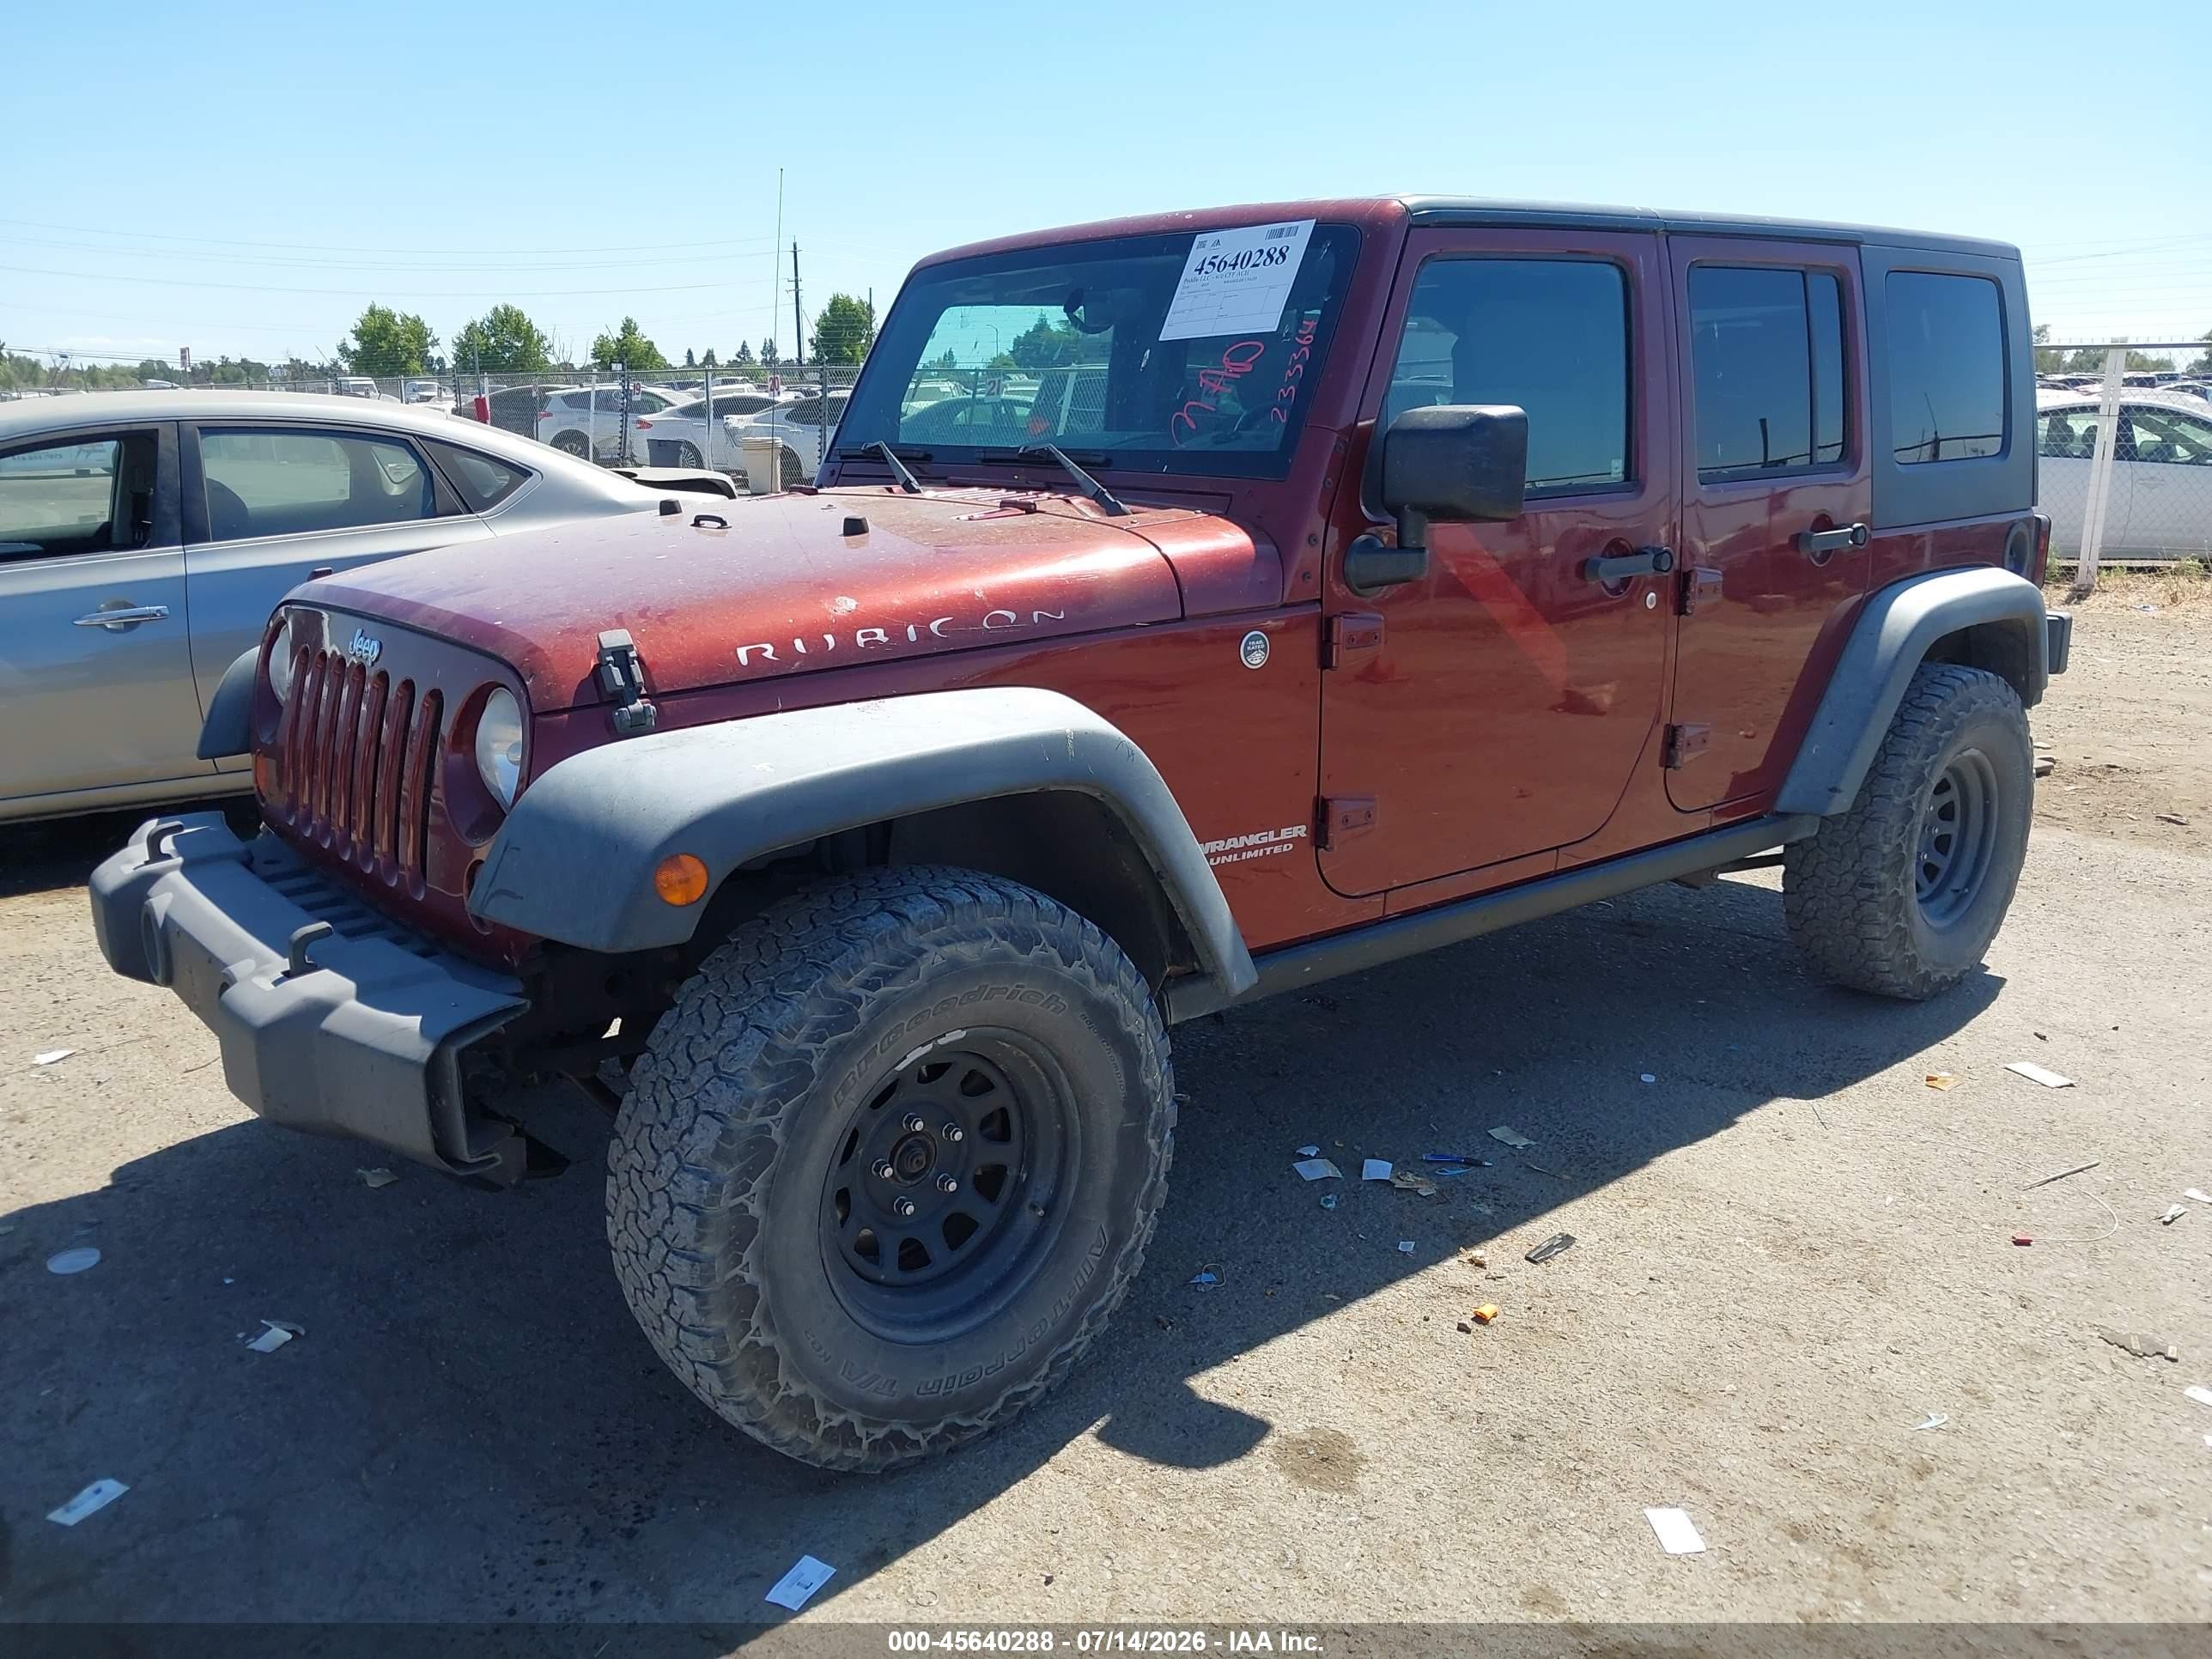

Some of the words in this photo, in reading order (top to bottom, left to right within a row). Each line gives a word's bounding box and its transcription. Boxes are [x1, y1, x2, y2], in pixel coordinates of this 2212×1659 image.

[1194, 246, 1290, 275] 45640288
[1271, 319, 1317, 422] 233364
[632, 382, 641, 396] 19
[769, 376, 780, 392] 20
[988, 379, 1001, 396] 21
[349, 628, 383, 666] Jeep
[736, 610, 1065, 666] RUBICON
[1209, 843, 1294, 866] UNLIMITED
